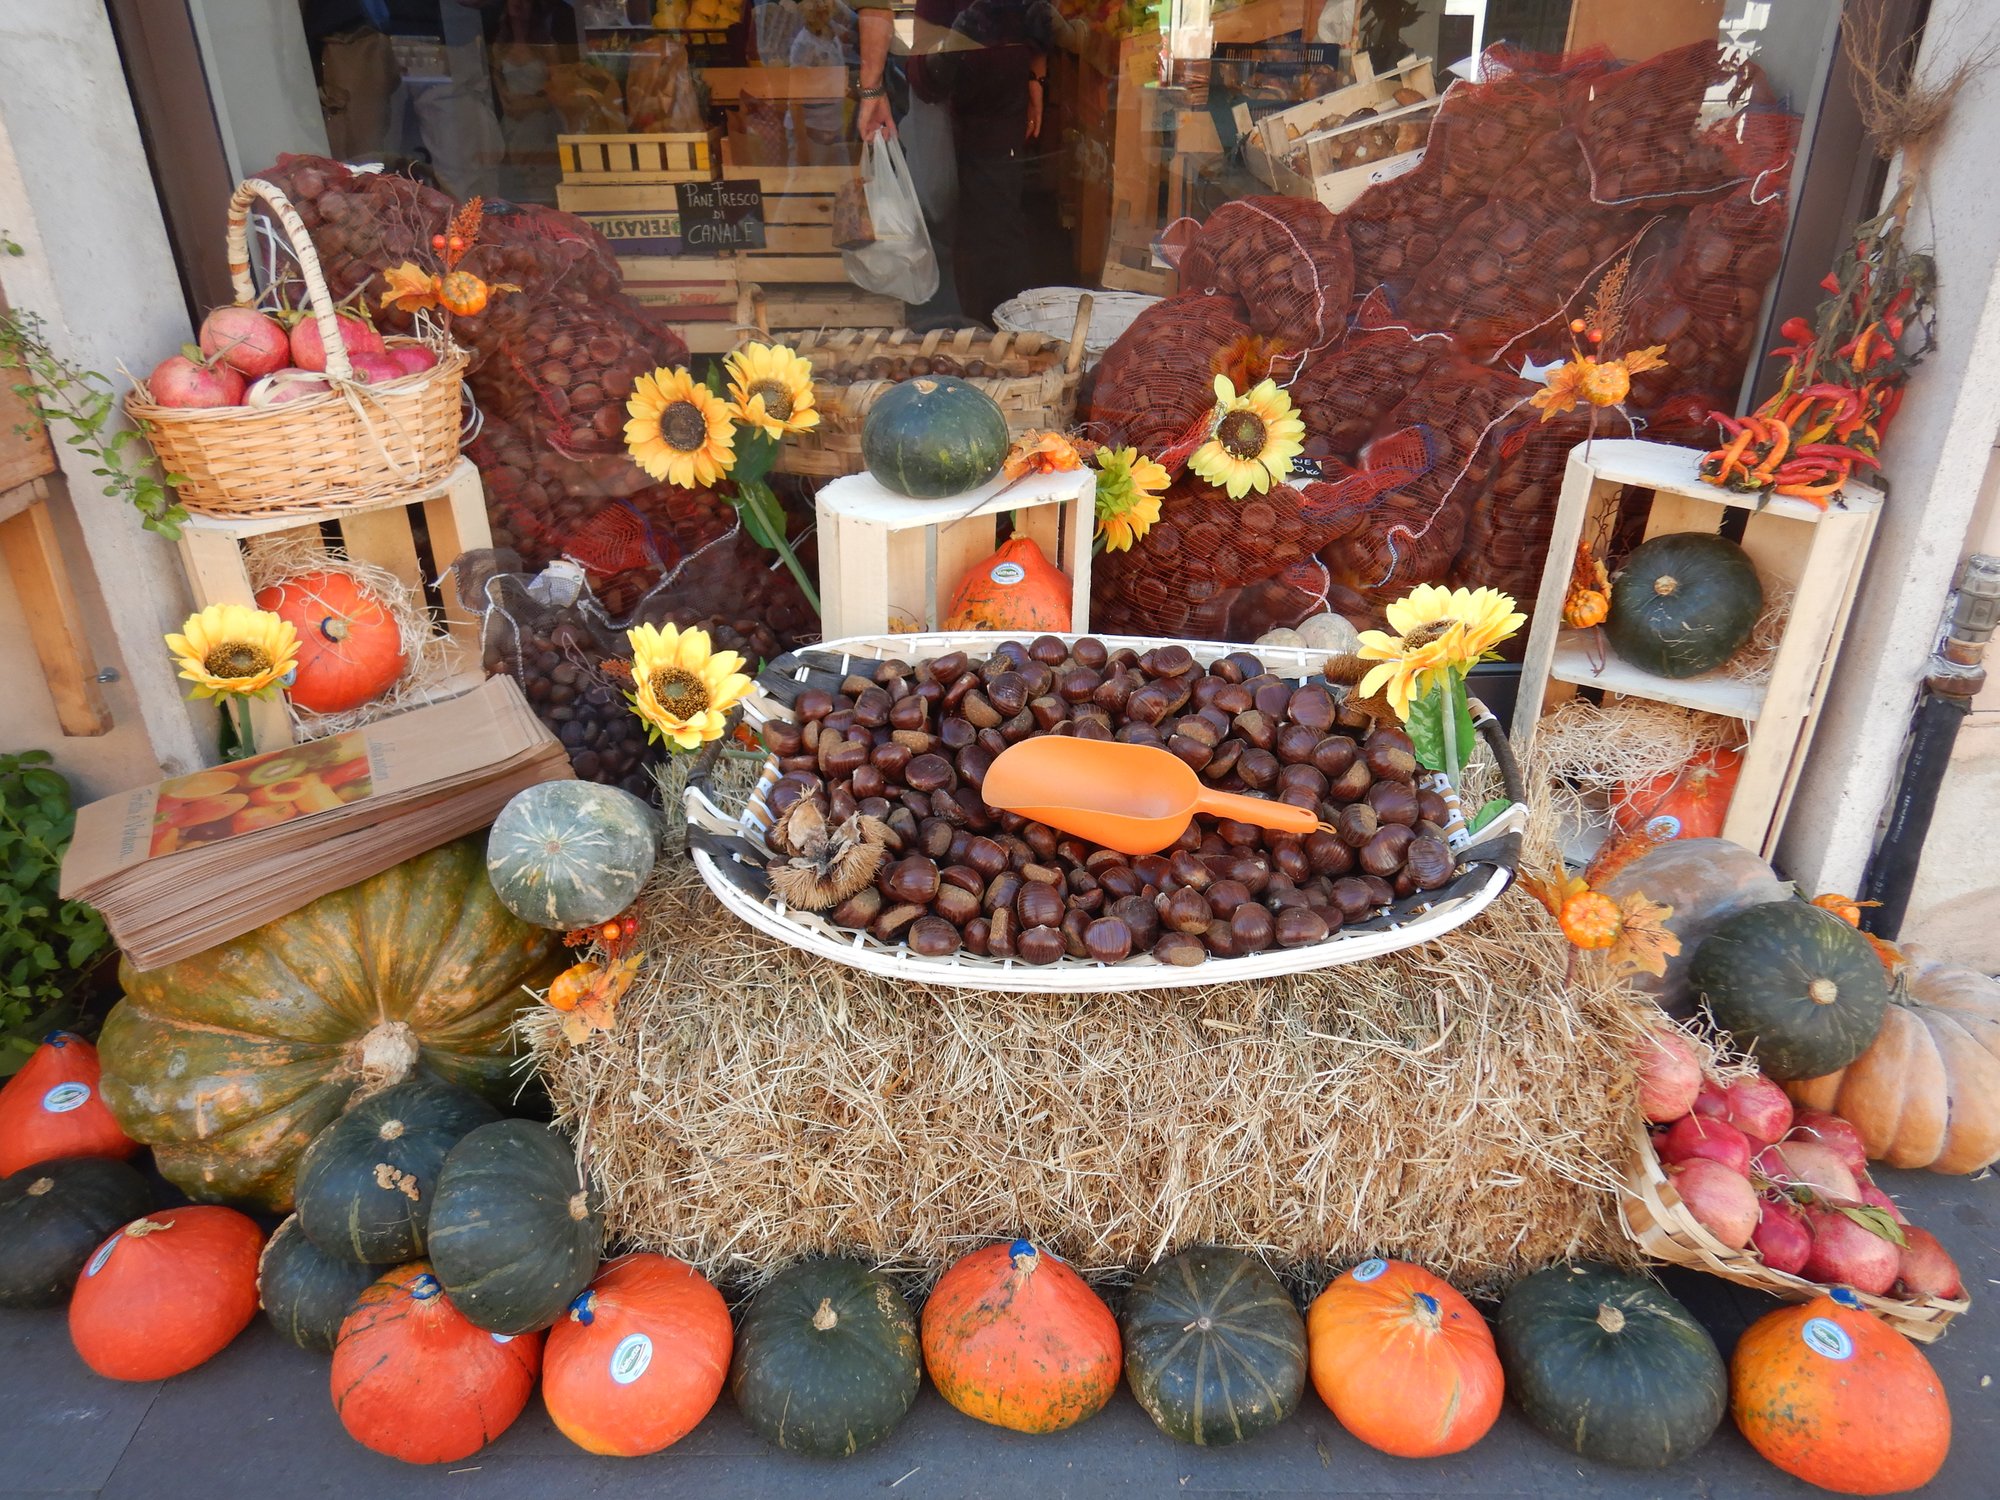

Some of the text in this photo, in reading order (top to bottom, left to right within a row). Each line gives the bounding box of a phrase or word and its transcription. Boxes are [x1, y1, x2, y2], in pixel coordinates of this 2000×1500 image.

[683, 182, 759, 207] PANE FRESCO
[712, 209, 726, 219] DI
[688, 221, 754, 244] CANALE
